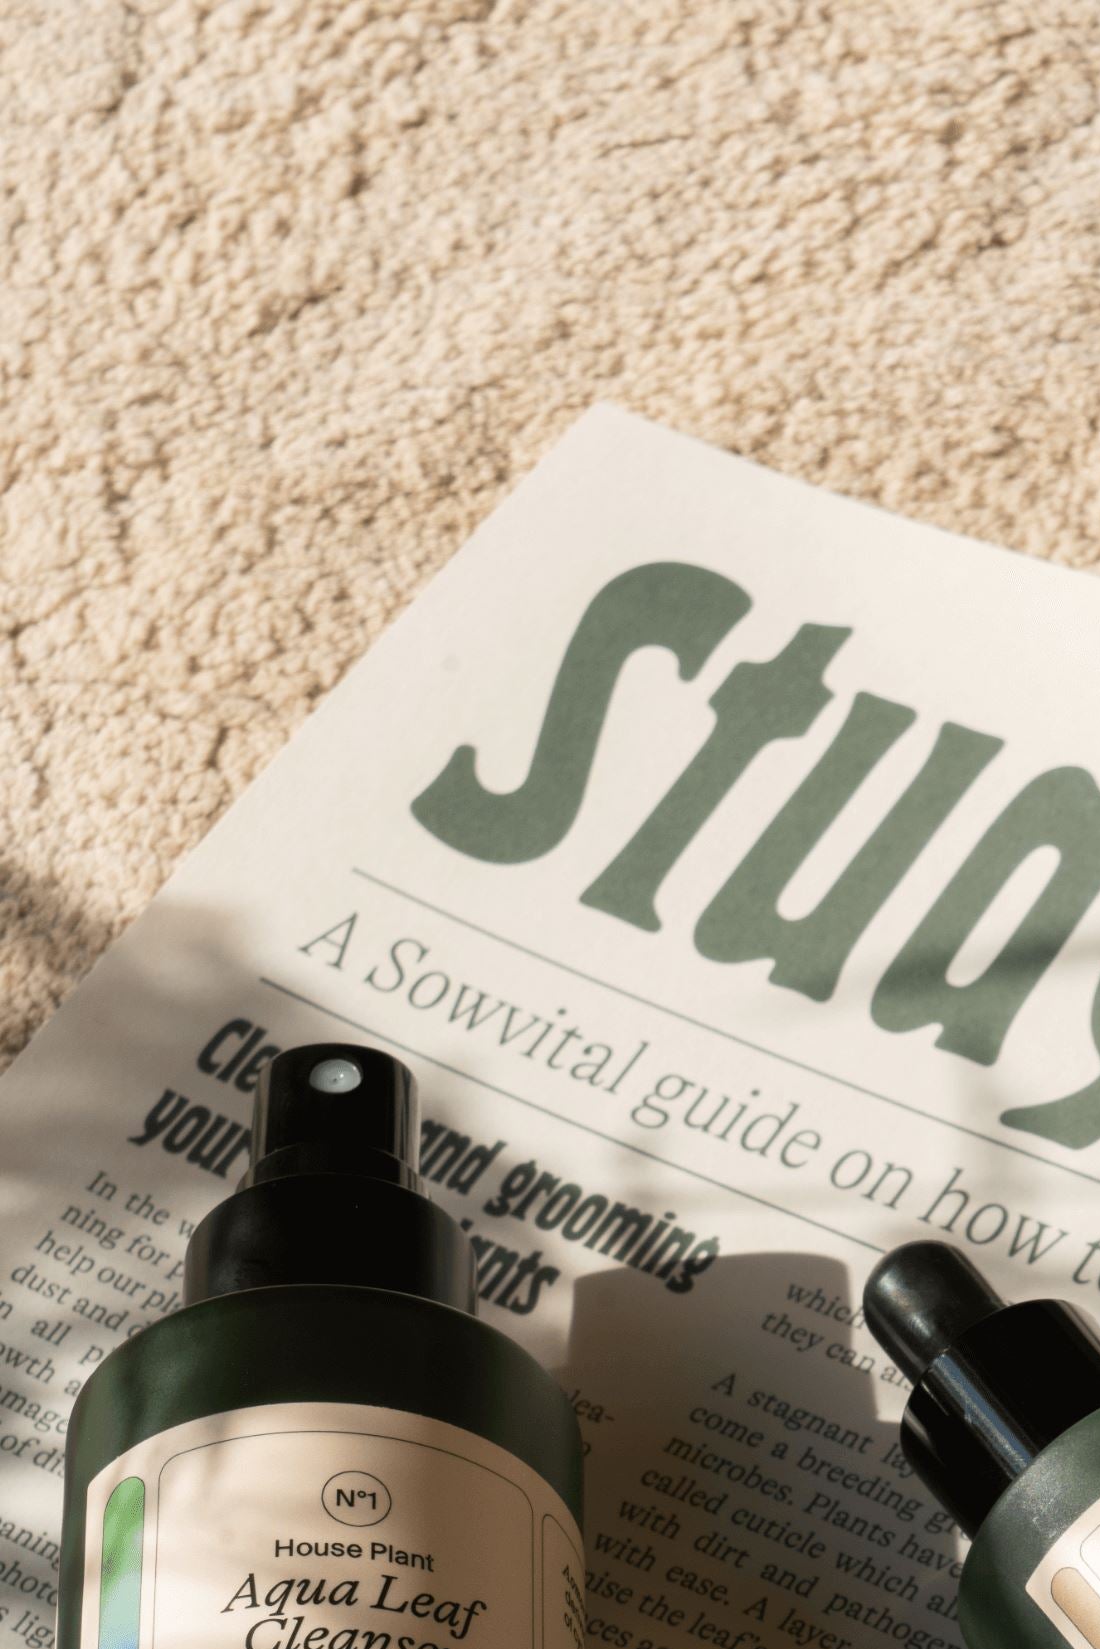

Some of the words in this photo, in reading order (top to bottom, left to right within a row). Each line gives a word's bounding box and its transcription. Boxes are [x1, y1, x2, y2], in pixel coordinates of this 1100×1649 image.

[298, 912, 357, 971] A
[365, 938, 649, 1095] Sowvital
[631, 1072, 820, 1169] guide
[830, 1150, 913, 1210] on
[918, 1168, 1069, 1265] how
[60, 1205, 125, 1249] ning
[124, 1234, 169, 1266] for
[124, 1193, 170, 1225] the
[483, 1160, 720, 1293] grooming
[34, 1229, 94, 1275] help
[97, 1267, 146, 1297] our
[9, 1264, 71, 1304] dust
[72, 1298, 129, 1331] and
[30, 1320, 73, 1346] all
[761, 1313, 824, 1352] they
[746, 1390, 874, 1454] stagnant
[661, 1435, 793, 1506] microbes.
[801, 1491, 896, 1547] Plants
[688, 1407, 764, 1448] come
[795, 1445, 922, 1522] breeding
[275, 1539, 363, 1558] House
[371, 1542, 434, 1572] Plant
[616, 1498, 681, 1541] with
[692, 1530, 751, 1568] dirt
[639, 1469, 729, 1515] called
[730, 1507, 826, 1559] cuticle
[834, 1550, 918, 1602] which
[592, 1532, 656, 1573] with
[664, 1565, 729, 1606] ease.
[221, 1573, 360, 1616] Aqua
[370, 1574, 487, 1640] Leaf
